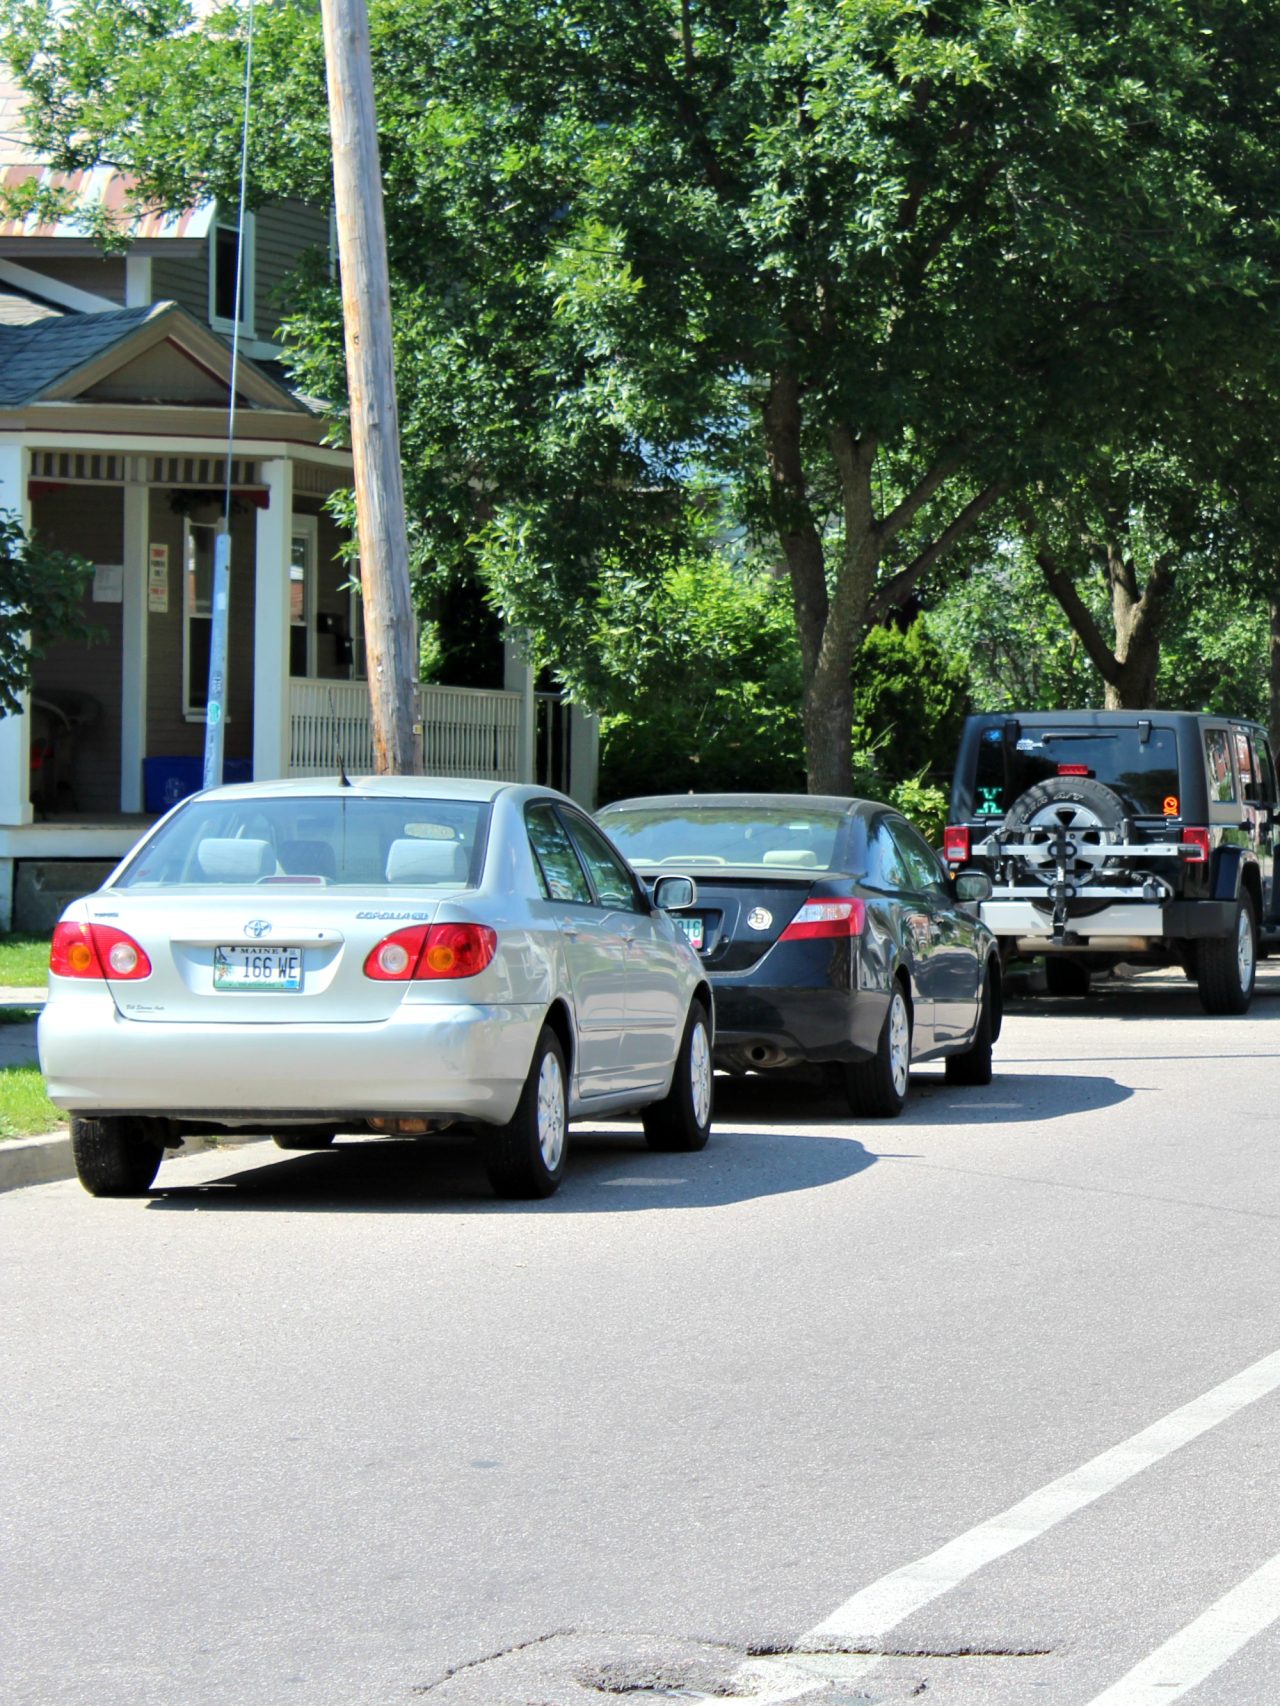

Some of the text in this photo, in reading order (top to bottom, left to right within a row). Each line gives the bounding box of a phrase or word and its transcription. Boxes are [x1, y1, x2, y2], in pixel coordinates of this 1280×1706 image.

[355, 911, 411, 920] COROLLA
[243, 956, 299, 979] 166 WE
